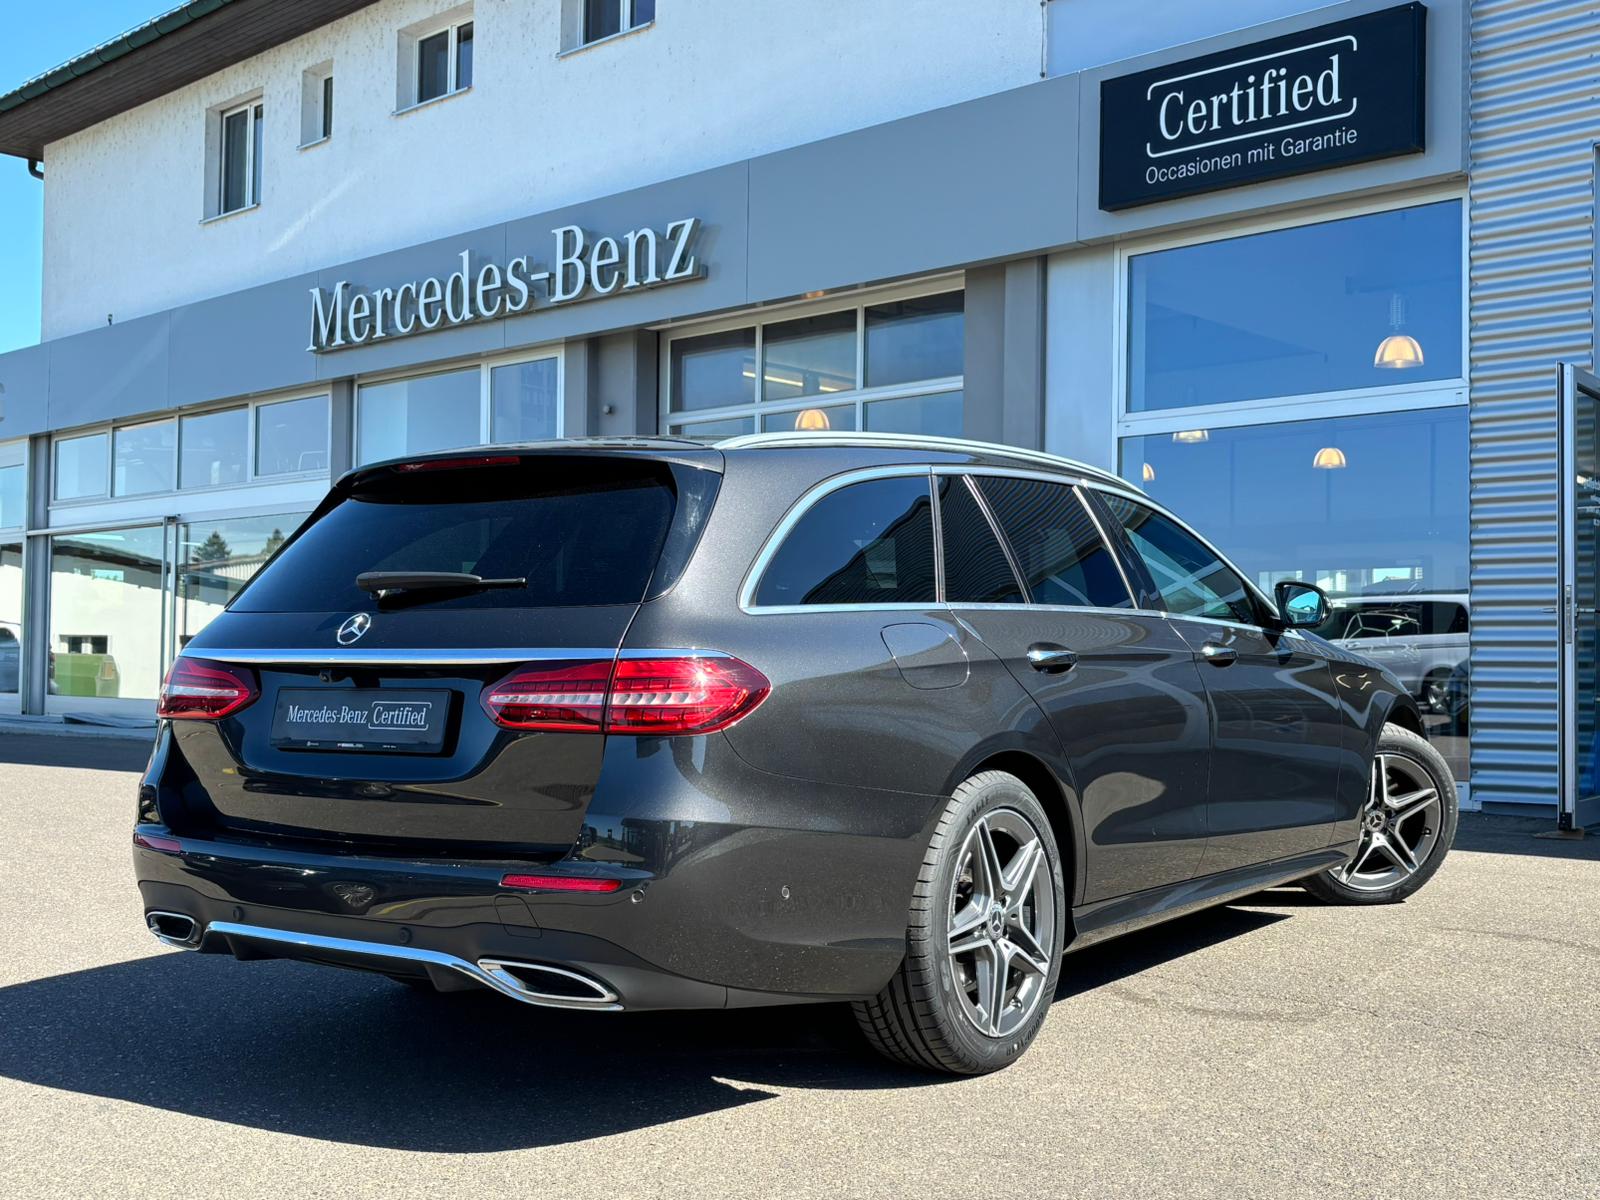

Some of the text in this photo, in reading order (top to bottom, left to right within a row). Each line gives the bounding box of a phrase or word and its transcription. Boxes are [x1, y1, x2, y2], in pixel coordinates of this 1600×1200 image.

[1159, 54, 1343, 140] Certified
[1145, 126, 1358, 184] Occasionen mit Garantie
[306, 217, 700, 352] Mercedes-Benz
[286, 705, 427, 726] Mercedes-Benz Certified
